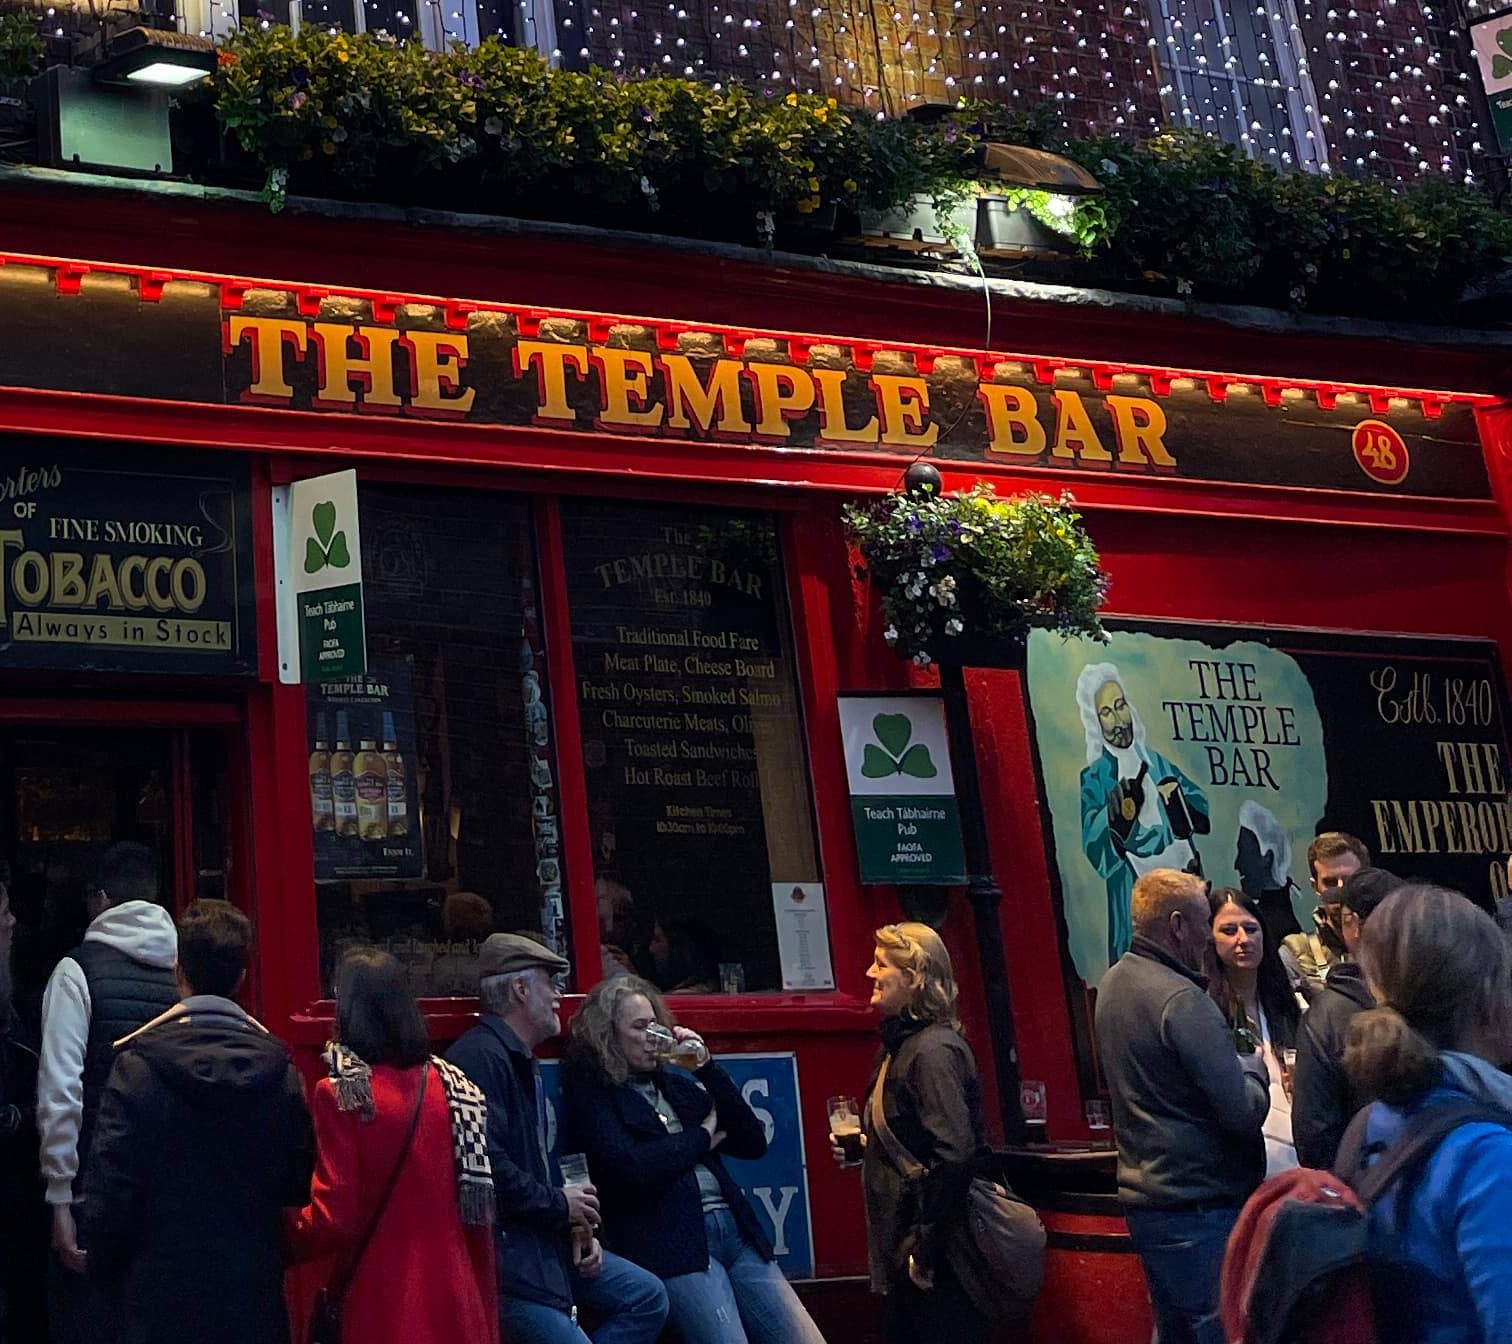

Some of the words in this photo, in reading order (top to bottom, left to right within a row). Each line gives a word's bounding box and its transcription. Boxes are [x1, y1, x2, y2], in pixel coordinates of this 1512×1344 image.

[227, 315, 478, 416] THE
[514, 339, 941, 450] TEMPLE
[976, 382, 1178, 470] BAR
[1360, 429, 1396, 471] 48
[13, 501, 37, 519] OF
[48, 517, 100, 543] FINE
[103, 520, 204, 548] SMOKING
[594, 551, 705, 590] TEMPLE
[710, 558, 763, 601] BAR
[682, 590, 713, 608] 1840
[16, 613, 109, 641] Always
[122, 621, 145, 641] in
[155, 618, 227, 646] Stock
[323, 617, 337, 633] Pub
[615, 625, 689, 646] Traditional
[692, 629, 727, 650] Food
[728, 632, 760, 651] Fare
[603, 652, 640, 673] Meat
[644, 654, 683, 676] Plate,
[683, 654, 733, 676] Cheese
[734, 658, 776, 679] Board
[320, 682, 364, 696] TEMPLE
[366, 683, 390, 697] BAR
[582, 680, 620, 701] Fresh
[623, 682, 679, 707] Oysters,
[681, 684, 736, 706] Smoked
[1188, 659, 1262, 702] THE
[1444, 676, 1494, 726] 1840
[602, 709, 682, 730] Charcuterie
[685, 713, 730, 734] Meats,
[1162, 701, 1301, 747] TEMPLE
[624, 738, 677, 759] Toasted
[680, 740, 758, 761] Sandwiches
[624, 766, 651, 786] Hot
[653, 767, 693, 787] Roast
[695, 768, 730, 787] Beef
[1204, 745, 1281, 792] BAR
[1436, 740, 1507, 796] THE
[863, 807, 895, 820] Teach
[897, 822, 918, 836] Pub
[890, 853, 933, 863] APPROVED
